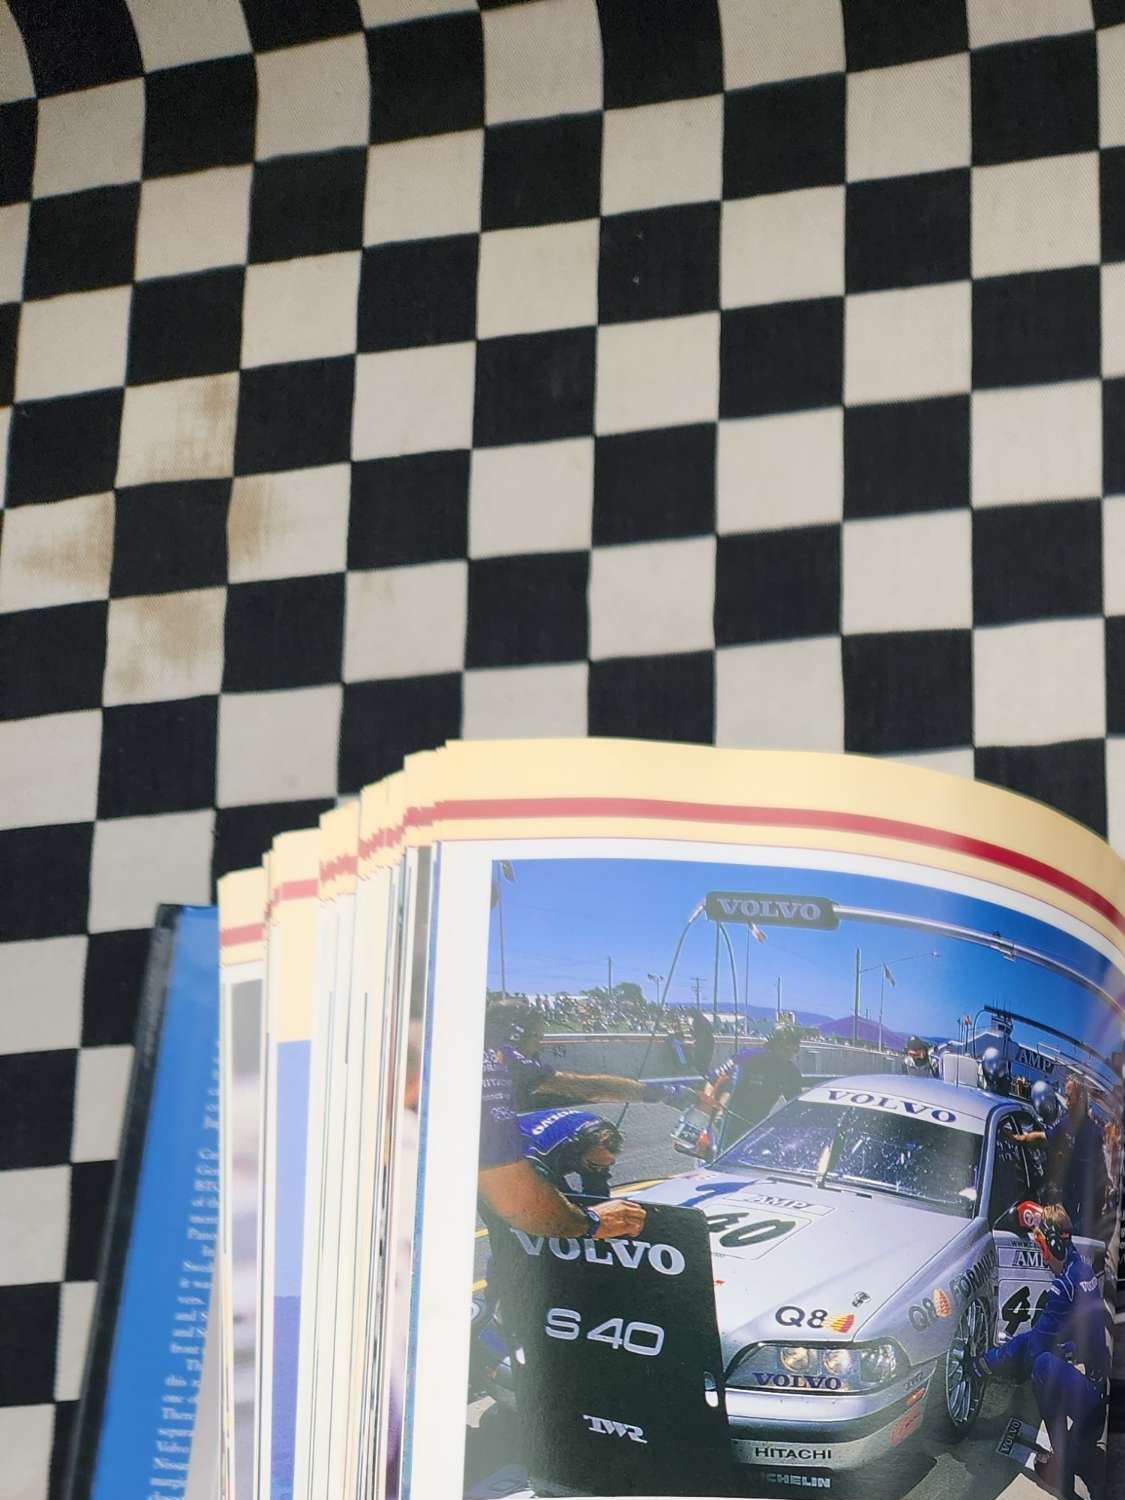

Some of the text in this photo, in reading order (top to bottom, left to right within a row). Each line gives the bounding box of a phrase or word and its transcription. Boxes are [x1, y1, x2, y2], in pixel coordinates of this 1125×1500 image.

[717, 898, 821, 921] VOLVO
[827, 1089, 957, 1124] VOLVO
[509, 1227, 686, 1276] VOLVO
[774, 1306, 829, 1329] Q8
[752, 1372, 842, 1391] VOLVO
[582, 1415, 648, 1444] TWR
[755, 1447, 832, 1460] HITACHI
